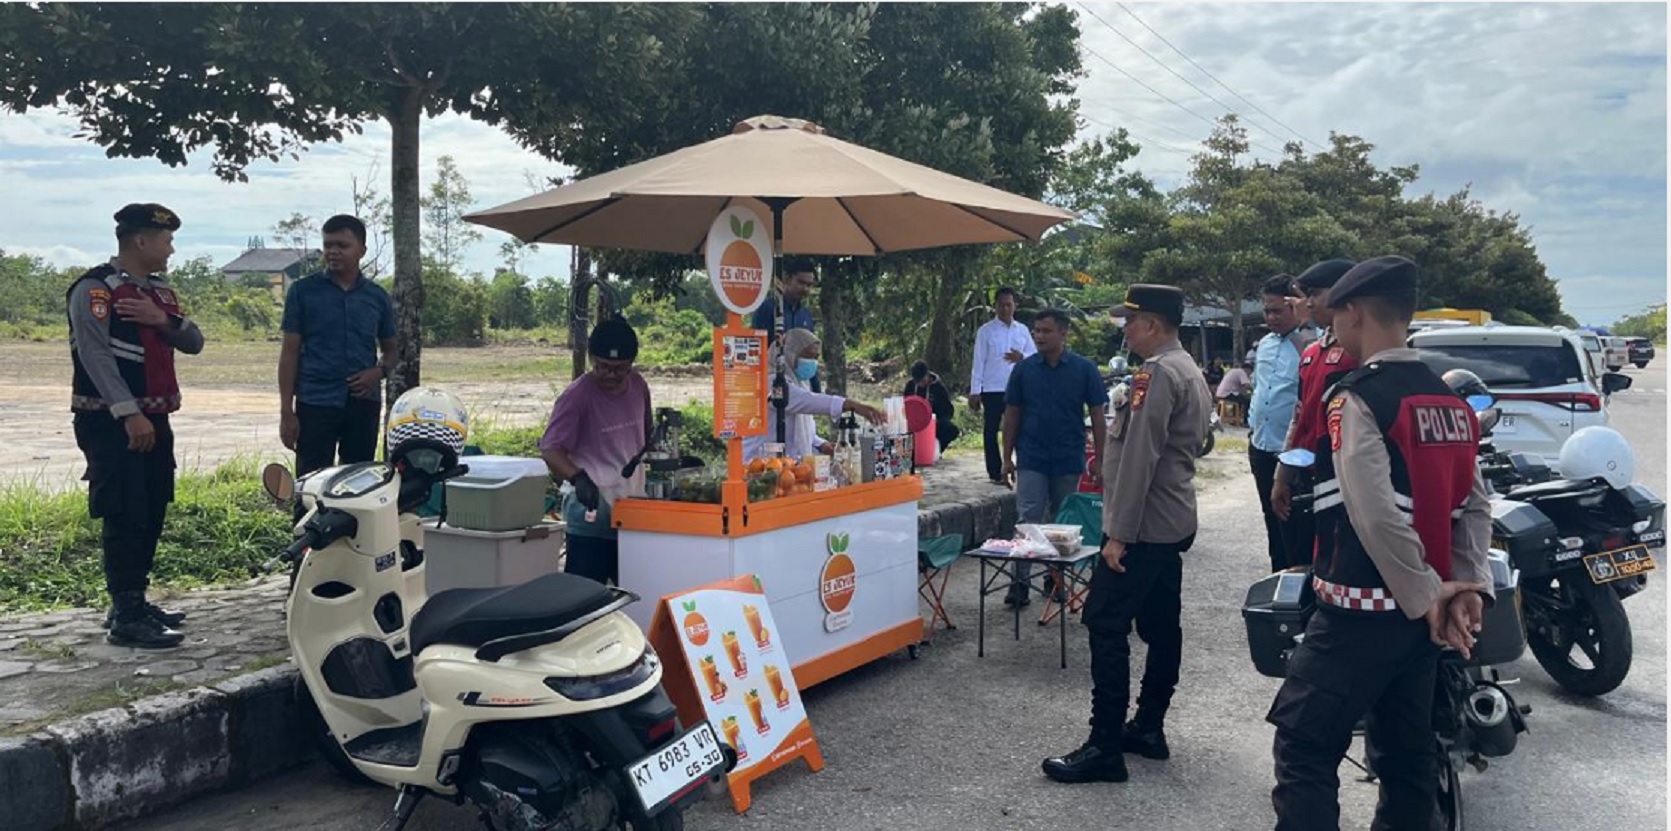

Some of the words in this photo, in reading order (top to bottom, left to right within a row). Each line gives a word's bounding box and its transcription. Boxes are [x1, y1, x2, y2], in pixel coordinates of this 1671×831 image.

[720, 267, 731, 280] ES
[1416, 407, 1473, 442] POLISI
[633, 764, 653, 787] KT
[658, 741, 691, 772] 6983
[692, 728, 714, 750] VR
